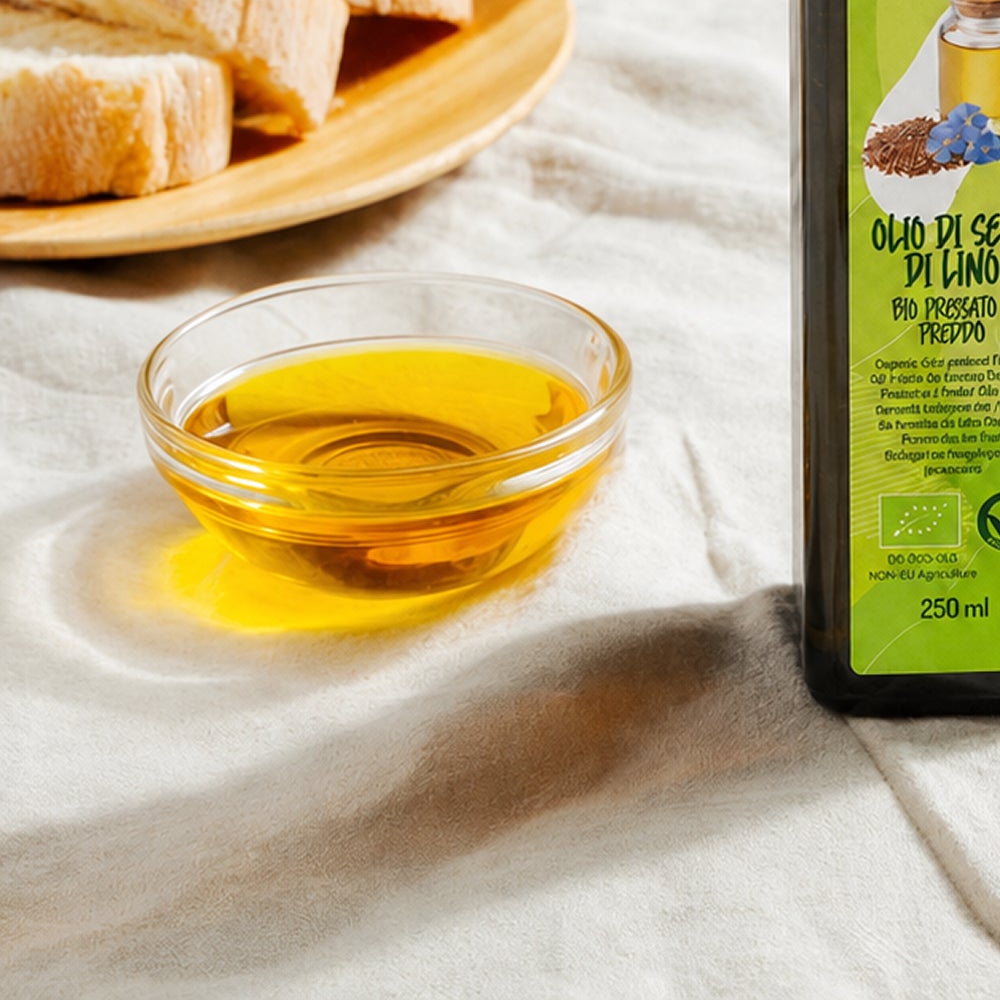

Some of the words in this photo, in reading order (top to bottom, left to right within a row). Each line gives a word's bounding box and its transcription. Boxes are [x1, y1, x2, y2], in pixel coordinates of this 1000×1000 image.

[871, 213, 926, 254] OLIO
[934, 213, 963, 250] DI
[904, 252, 934, 288] DI
[941, 247, 1000, 290] LINO
[891, 296, 918, 321] BIO
[920, 597, 960, 619] 250
[964, 596, 989, 618] ml
